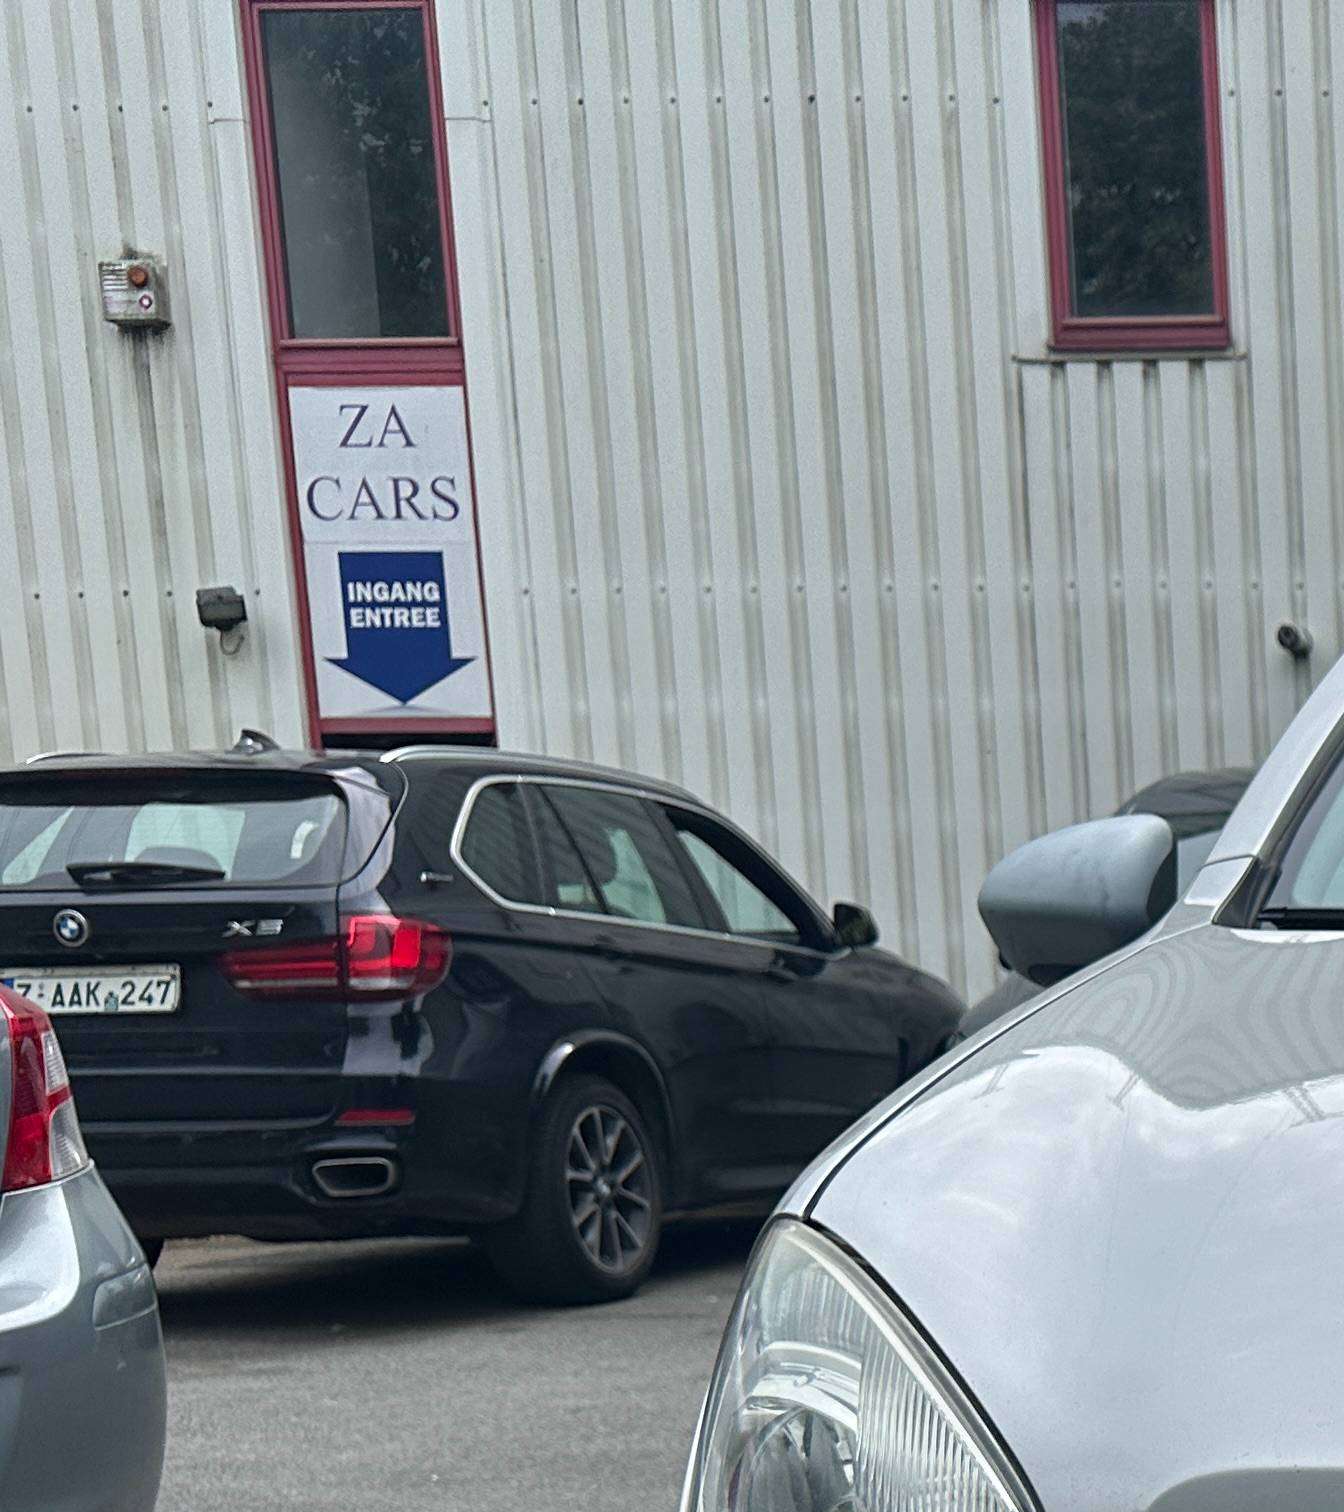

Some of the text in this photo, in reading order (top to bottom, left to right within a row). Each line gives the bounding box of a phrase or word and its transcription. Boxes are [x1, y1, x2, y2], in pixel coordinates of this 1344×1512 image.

[339, 403, 417, 448] ZA
[306, 475, 460, 522] CARS
[347, 581, 441, 603] INGANG
[349, 607, 442, 629] ENTREE
